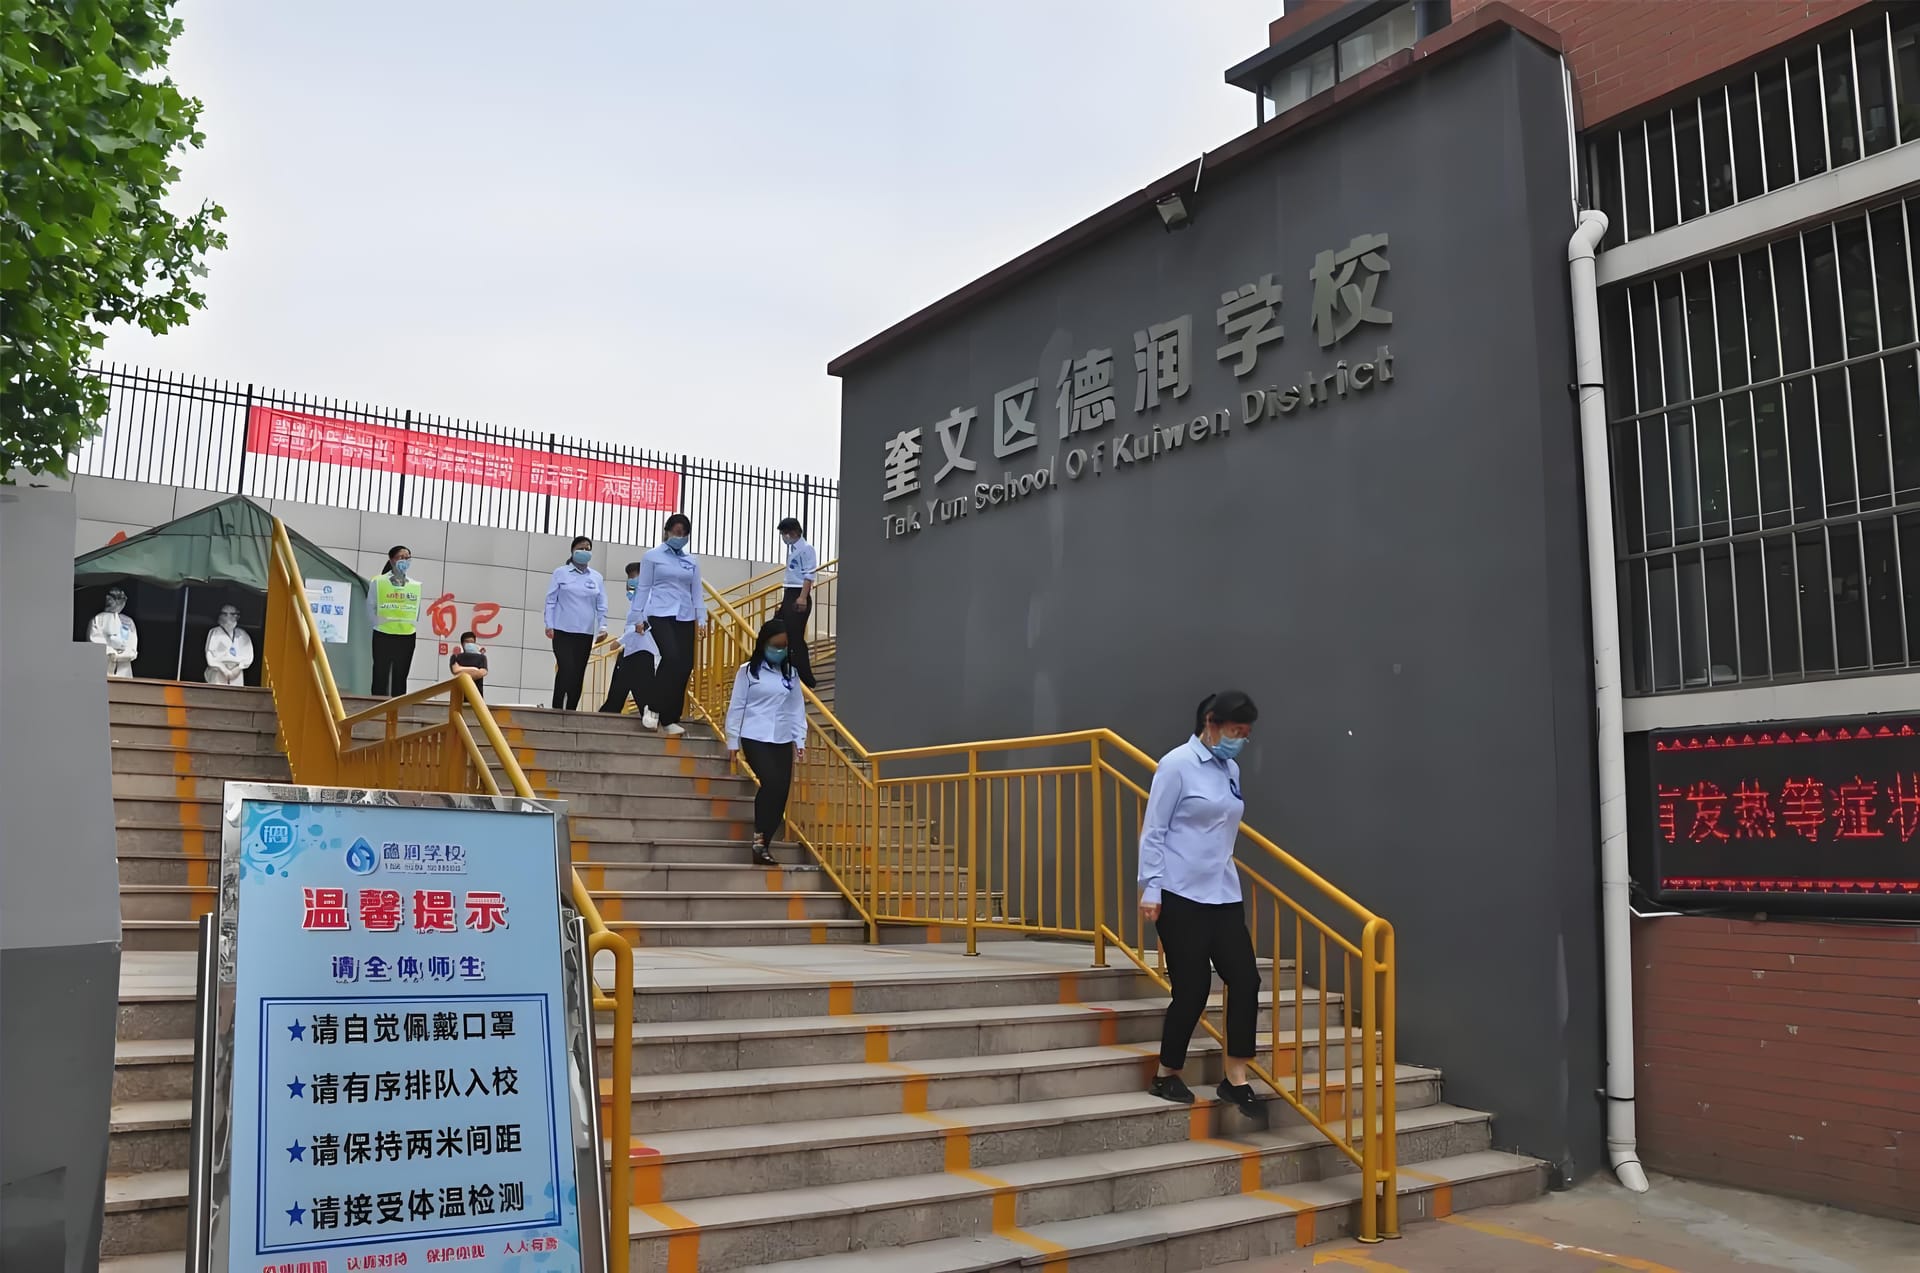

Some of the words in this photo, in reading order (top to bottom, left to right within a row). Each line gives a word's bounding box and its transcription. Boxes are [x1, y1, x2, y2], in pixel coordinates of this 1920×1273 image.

[883, 233, 1393, 501] 奎文区德润学校
[882, 505, 921, 540] Tak
[974, 456, 1058, 510] School
[1065, 440, 1104, 479] Of
[1112, 408, 1231, 468] Kuiwen
[1240, 345, 1394, 425] District
[302, 886, 508, 934] 温馨提示
[331, 955, 485, 983] 请全体师生
[311, 1011, 516, 1045] 请自觉佩戴口罩
[311, 1066, 519, 1105] 请有序排队入校
[311, 1124, 522, 1166] 请保持两米间距
[311, 1181, 524, 1230] 请接受体温检测
